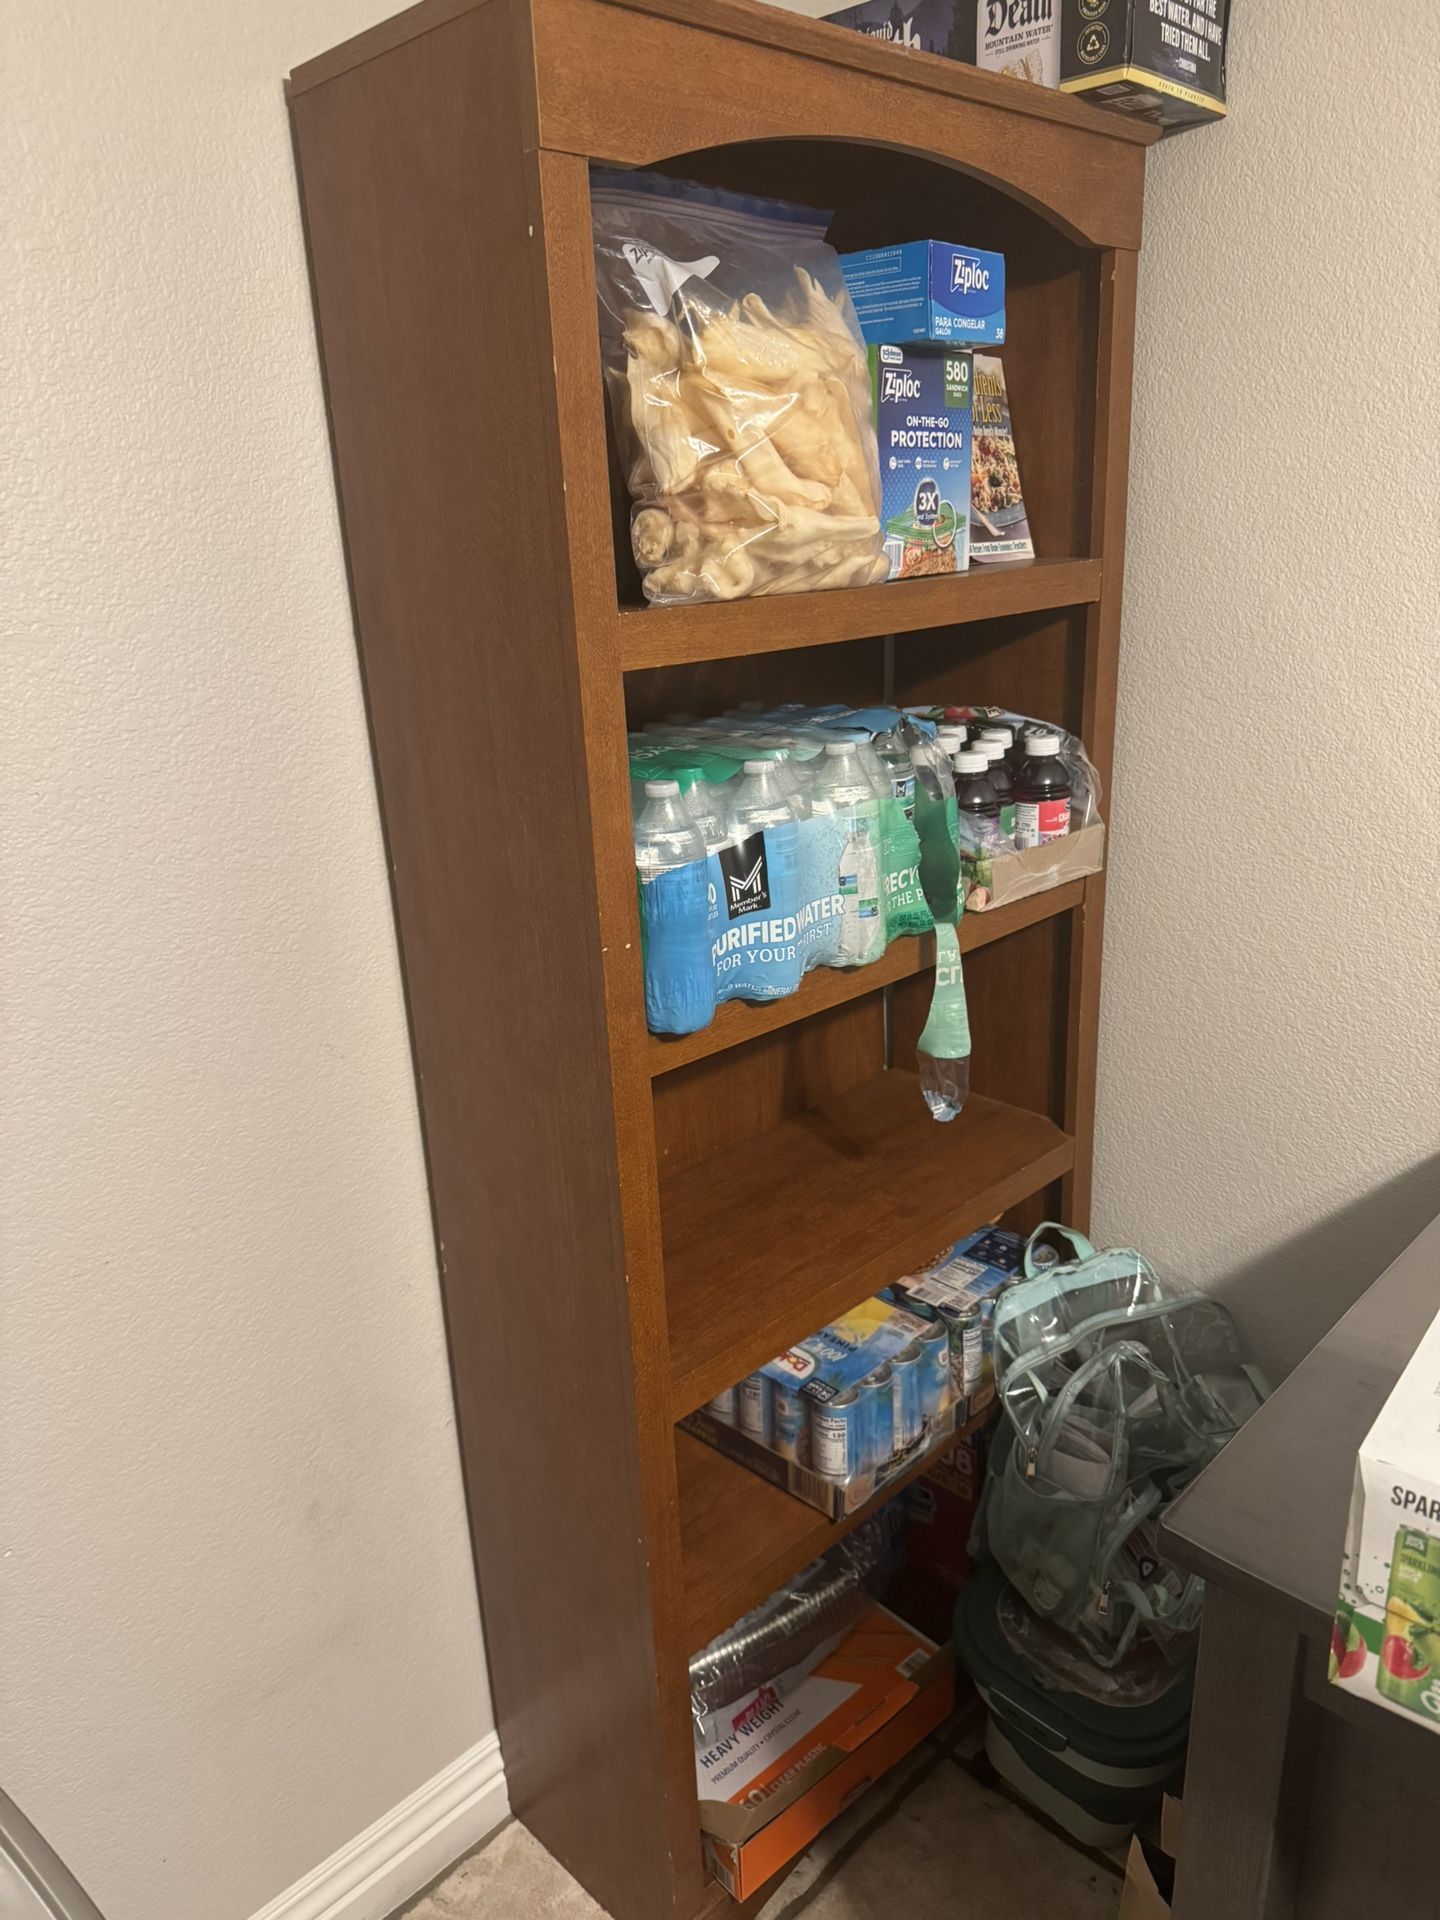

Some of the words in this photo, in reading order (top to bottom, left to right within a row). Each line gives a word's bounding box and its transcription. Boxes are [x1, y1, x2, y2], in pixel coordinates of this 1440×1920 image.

[1149, 0, 1168, 18] BEST
[1191, 13, 1205, 36] AND
[1207, 21, 1222, 46] HAVE
[985, 31, 1024, 51] MOUNTAIN
[1025, 25, 1052, 38] WATER
[1026, 37, 1040, 47] WATER
[1160, 22, 1181, 48] TRIED
[1180, 31, 1198, 56] THEM
[954, 259, 990, 295] Ziploc
[935, 316, 953, 328] PARA
[953, 317, 986, 330] CONGELAR
[995, 328, 1004, 340] 38
[946, 361, 969, 382] 580
[885, 372, 921, 403] Ziploc
[906, 416, 950, 429] ON-THE-GO
[980, 396, 1003, 424] Less
[890, 430, 963, 449] PROTECTION
[918, 492, 937, 511] 3X
[885, 865, 920, 897] RECY
[730, 891, 768, 912] Member's
[738, 902, 759, 914] Mark
[892, 891, 914, 910] THE
[711, 916, 797, 967] PURIFIED
[796, 893, 846, 934] WATER
[716, 952, 742, 977] FOR
[746, 945, 797, 965] YOUR
[699, 1731, 741, 1769] HEAVY
[739, 1698, 785, 1737] WEIGHT
[711, 1760, 738, 1784] PREMIUM
[737, 1744, 761, 1765] QUALITY
[764, 1724, 785, 1743] CRYSTAL
